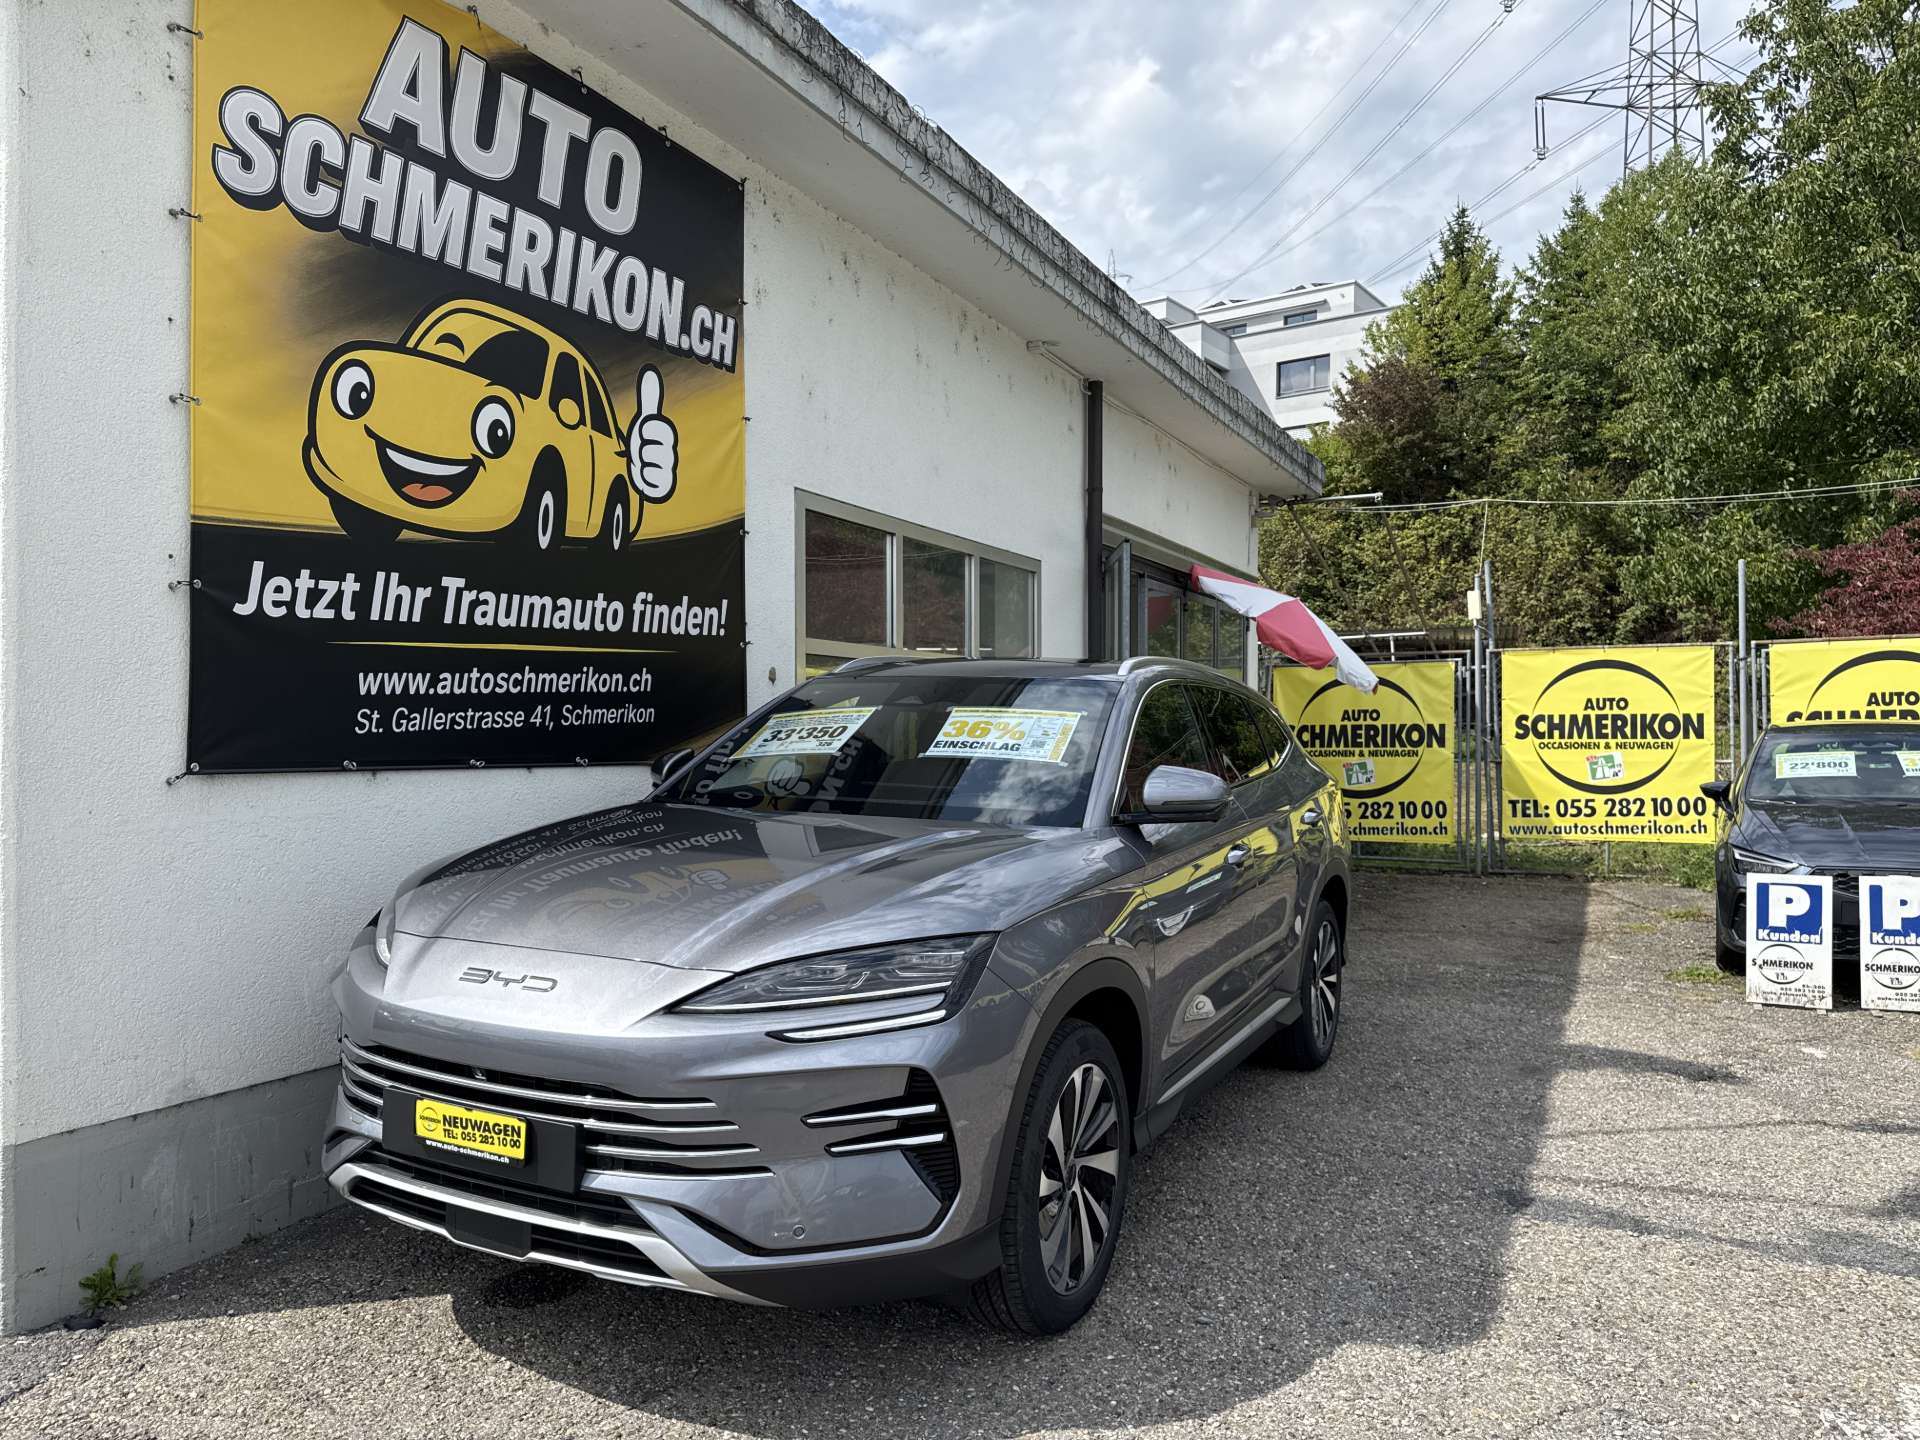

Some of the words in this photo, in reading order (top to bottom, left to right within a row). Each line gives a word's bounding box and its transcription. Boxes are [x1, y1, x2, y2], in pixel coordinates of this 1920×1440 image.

[360, 17, 643, 236] AUTO
[214, 87, 738, 369] SCHMERIKON.CH
[232, 560, 361, 621] Jetzt
[370, 571, 433, 622] Ihr
[441, 576, 624, 632] Traumauto
[632, 592, 729, 636] finden!
[358, 666, 653, 695] www.autoschmerikon.ch
[1583, 697, 1629, 711] AUTO
[1866, 691, 1920, 706] AUTO
[354, 708, 383, 734] St.
[392, 706, 525, 733] Gallerstrasse
[530, 705, 554, 731] 41,
[560, 703, 655, 726] Schmerikon
[1341, 709, 1381, 722] AUTO
[762, 725, 849, 743] 33'350
[943, 719, 1026, 741] 36%
[1289, 723, 1446, 748] CHMERIKON
[1514, 713, 1705, 740] SCHMERIKON
[932, 740, 1022, 752] EINSCHLAG
[1368, 750, 1419, 758] NEUWAGEN
[1538, 741, 1600, 750] OCCASIONEN
[1604, 741, 1611, 750] &
[1615, 741, 1674, 750] NEUWAGEN
[1357, 801, 1394, 820] 282
[1400, 801, 1418, 819] 10
[1421, 800, 1447, 819] 00
[1508, 799, 1550, 818] TEL:
[1556, 798, 1597, 818] 055
[1604, 798, 1646, 817] 282
[1651, 798, 1673, 817] 10
[1677, 797, 1707, 817] 00
[1509, 820, 1708, 835] www.autoschmerikon.ch
[1768, 884, 1811, 928] P
[1757, 928, 1821, 944] Kunden
[458, 966, 558, 993] BYD
[442, 1114, 522, 1139] NEUWAGEN
[443, 1128, 459, 1140] TEL:
[461, 1131, 477, 1143] 055
[479, 1133, 496, 1146] 282
[498, 1135, 508, 1148] 10
[509, 1138, 521, 1149] 00
